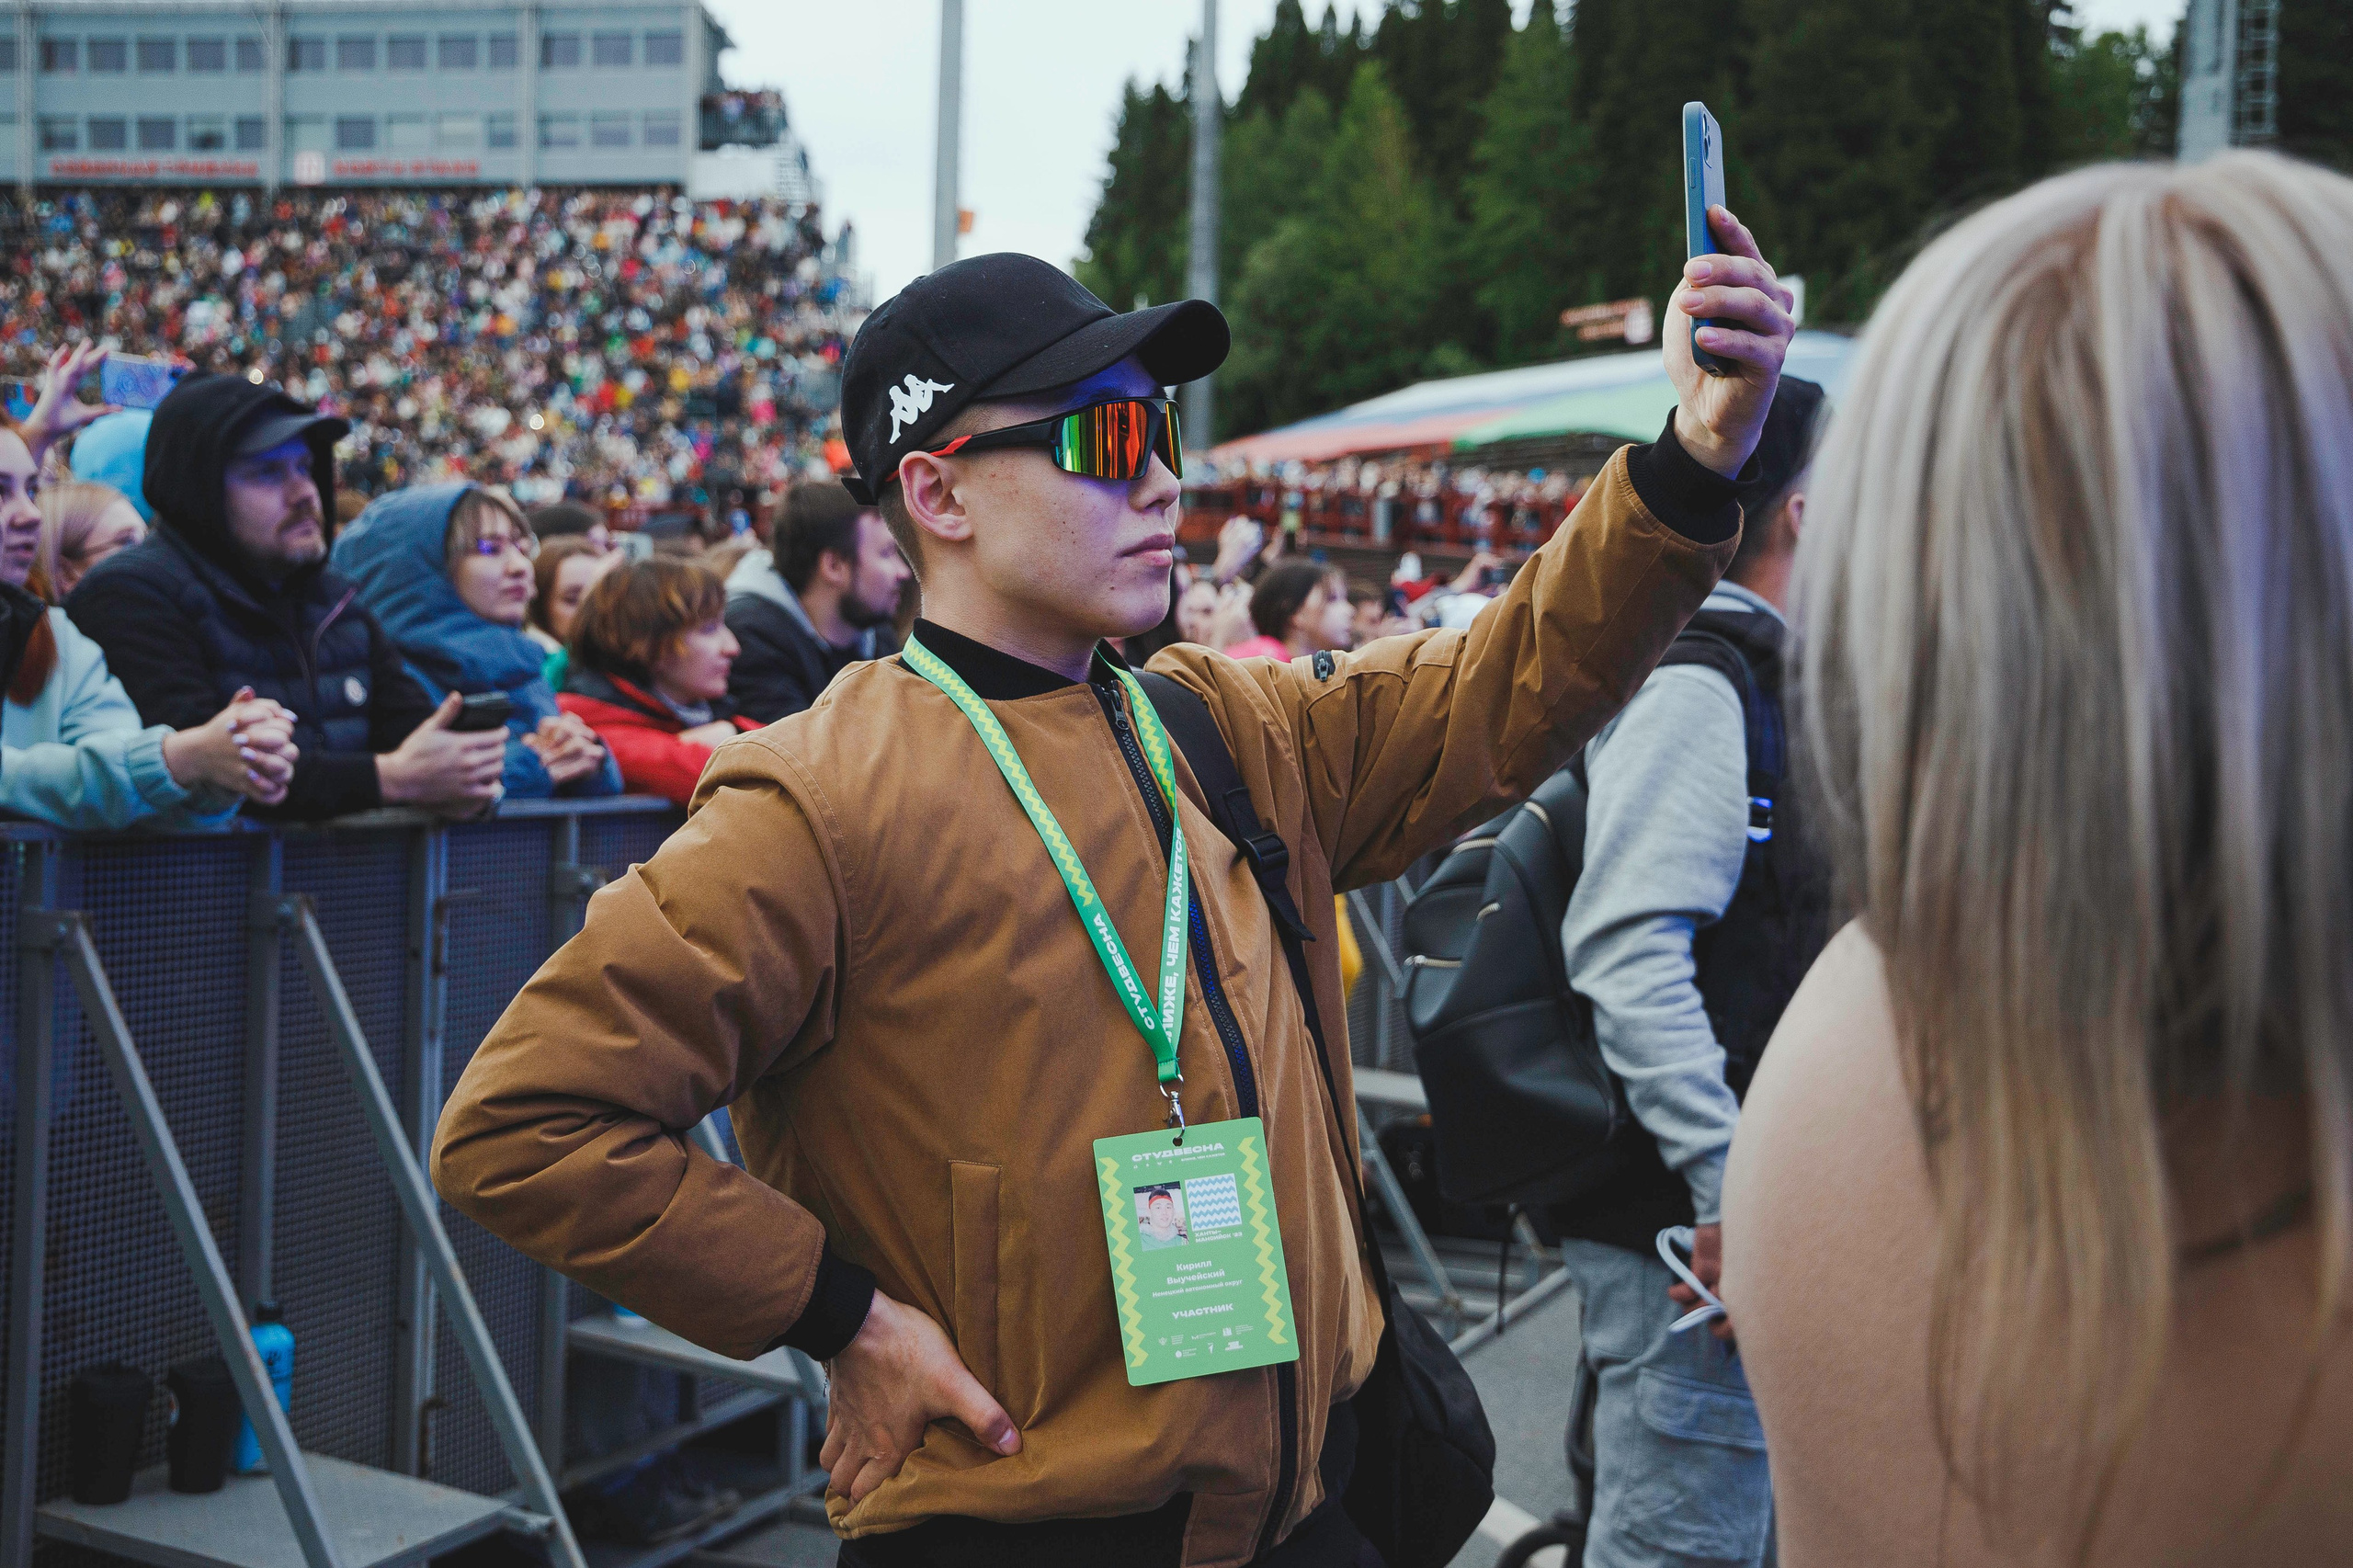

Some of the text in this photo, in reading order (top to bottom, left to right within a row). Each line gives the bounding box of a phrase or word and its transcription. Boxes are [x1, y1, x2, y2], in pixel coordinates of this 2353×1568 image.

[1169, 826, 1183, 923] КАЖЕТСЯ
[1166, 927, 1181, 967] ЧЕМ
[1094, 913, 1155, 1030] СТУДВЕСНА
[1131, 1142, 1224, 1162] СТУДВЕСНА
[1176, 1260, 1212, 1272] Кирилл
[1166, 1268, 1225, 1285] Выучейский
[1172, 1303, 1233, 1320] УЧАСТНИК
